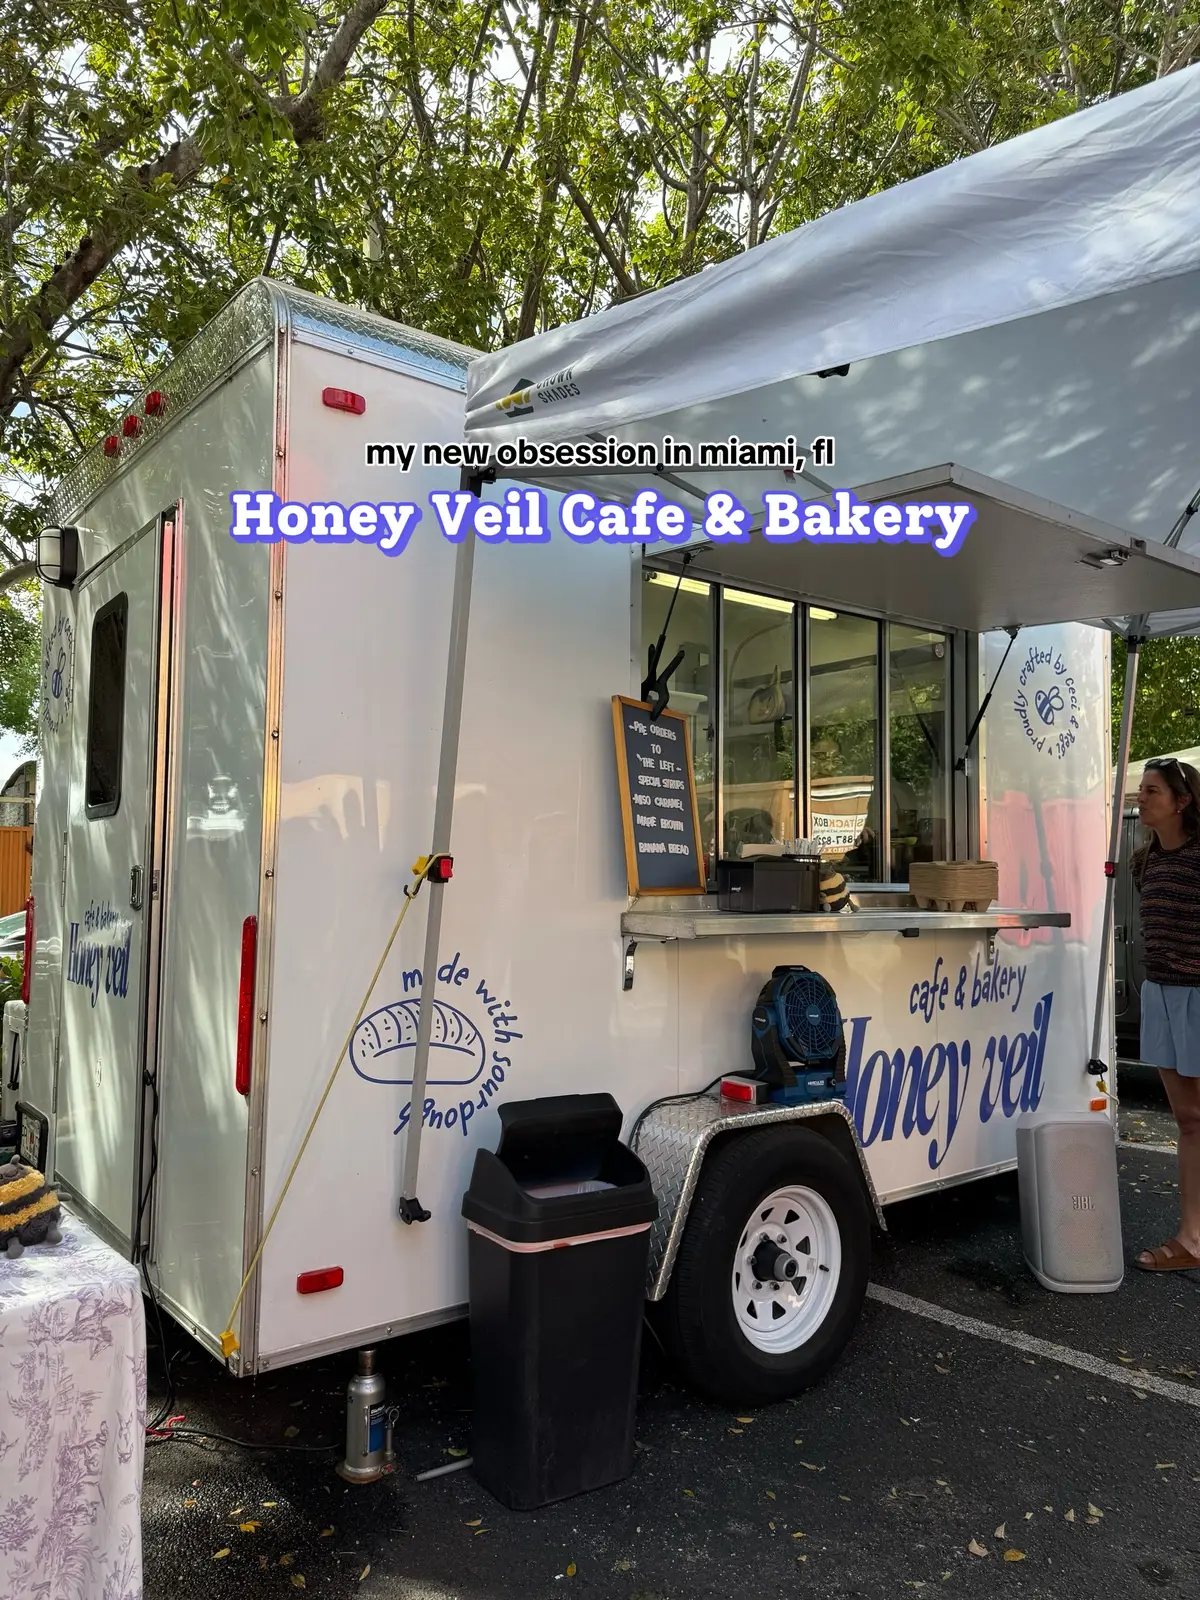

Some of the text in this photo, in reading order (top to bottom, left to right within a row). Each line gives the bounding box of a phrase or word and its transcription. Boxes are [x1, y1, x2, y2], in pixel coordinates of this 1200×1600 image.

[537, 383, 581, 404] SHADES
[1019, 646, 1053, 686] crafted
[1053, 653, 1067, 676] by
[1065, 677, 1081, 712] ceci
[1013, 688, 1046, 753] proudly
[1069, 714, 1080, 729] &
[650, 724, 677, 741] ORDERS
[650, 743, 662, 755] TO
[659, 760, 675, 772] LEFT
[638, 842, 690, 856] BANANA BREAD
[67, 922, 133, 1009] Honey veil
[909, 948, 1027, 1023] cafe & bakery
[402, 952, 470, 993] mde
[475, 979, 524, 1044] with
[979, 991, 1054, 1124] veil
[1072, 1195, 1096, 1211] JBL
